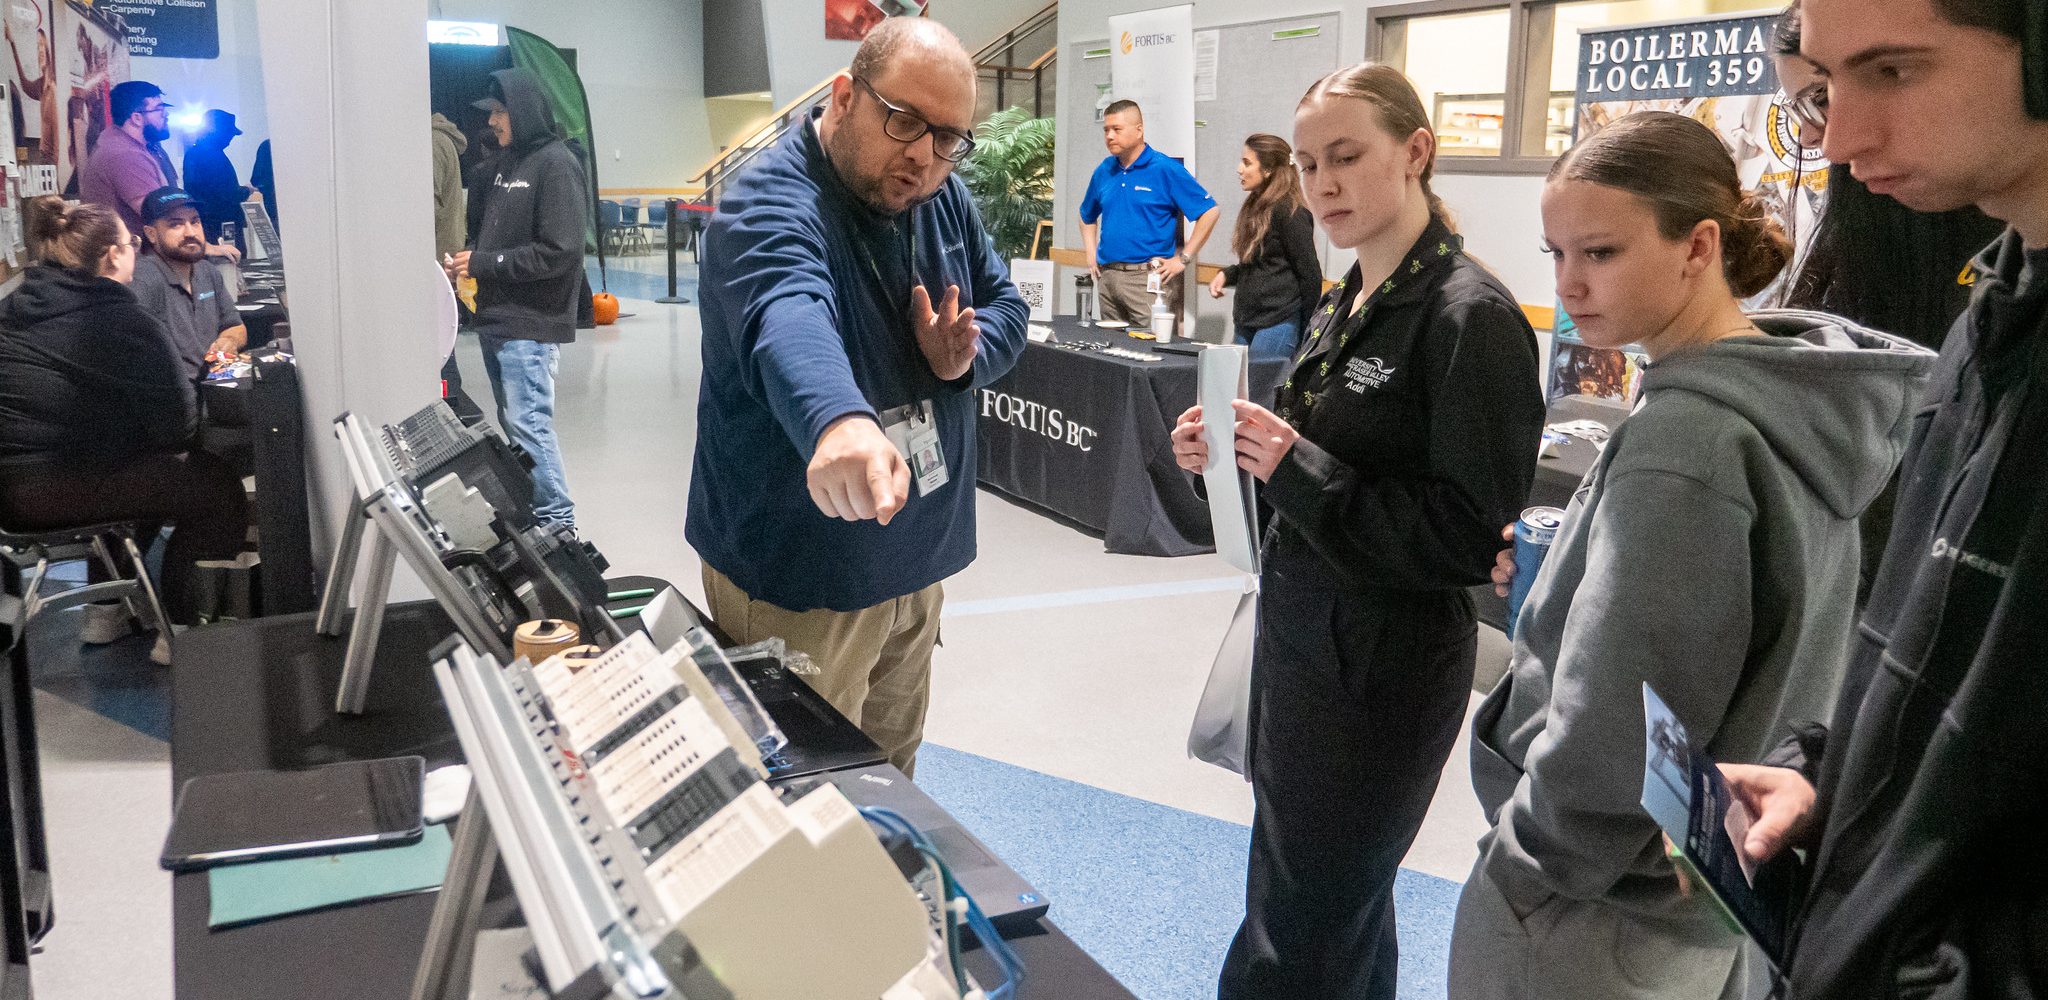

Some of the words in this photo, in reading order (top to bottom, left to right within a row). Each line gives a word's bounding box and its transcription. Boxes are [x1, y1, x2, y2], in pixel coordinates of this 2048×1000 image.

[110, 4, 156, 16] Carpentry
[166, 0, 206, 8] Collision
[127, 26, 147, 35] nery
[127, 36, 158, 46] mbing
[1135, 33, 1165, 48] FORTIS
[1165, 34, 1176, 44] BC
[1589, 25, 1766, 65] BOILERMA
[129, 45, 153, 55] lding
[1586, 62, 1692, 93] LOCAL
[1706, 57, 1764, 87] 359
[1345, 380, 1366, 394] Addi
[981, 388, 1063, 440] FORTIS
